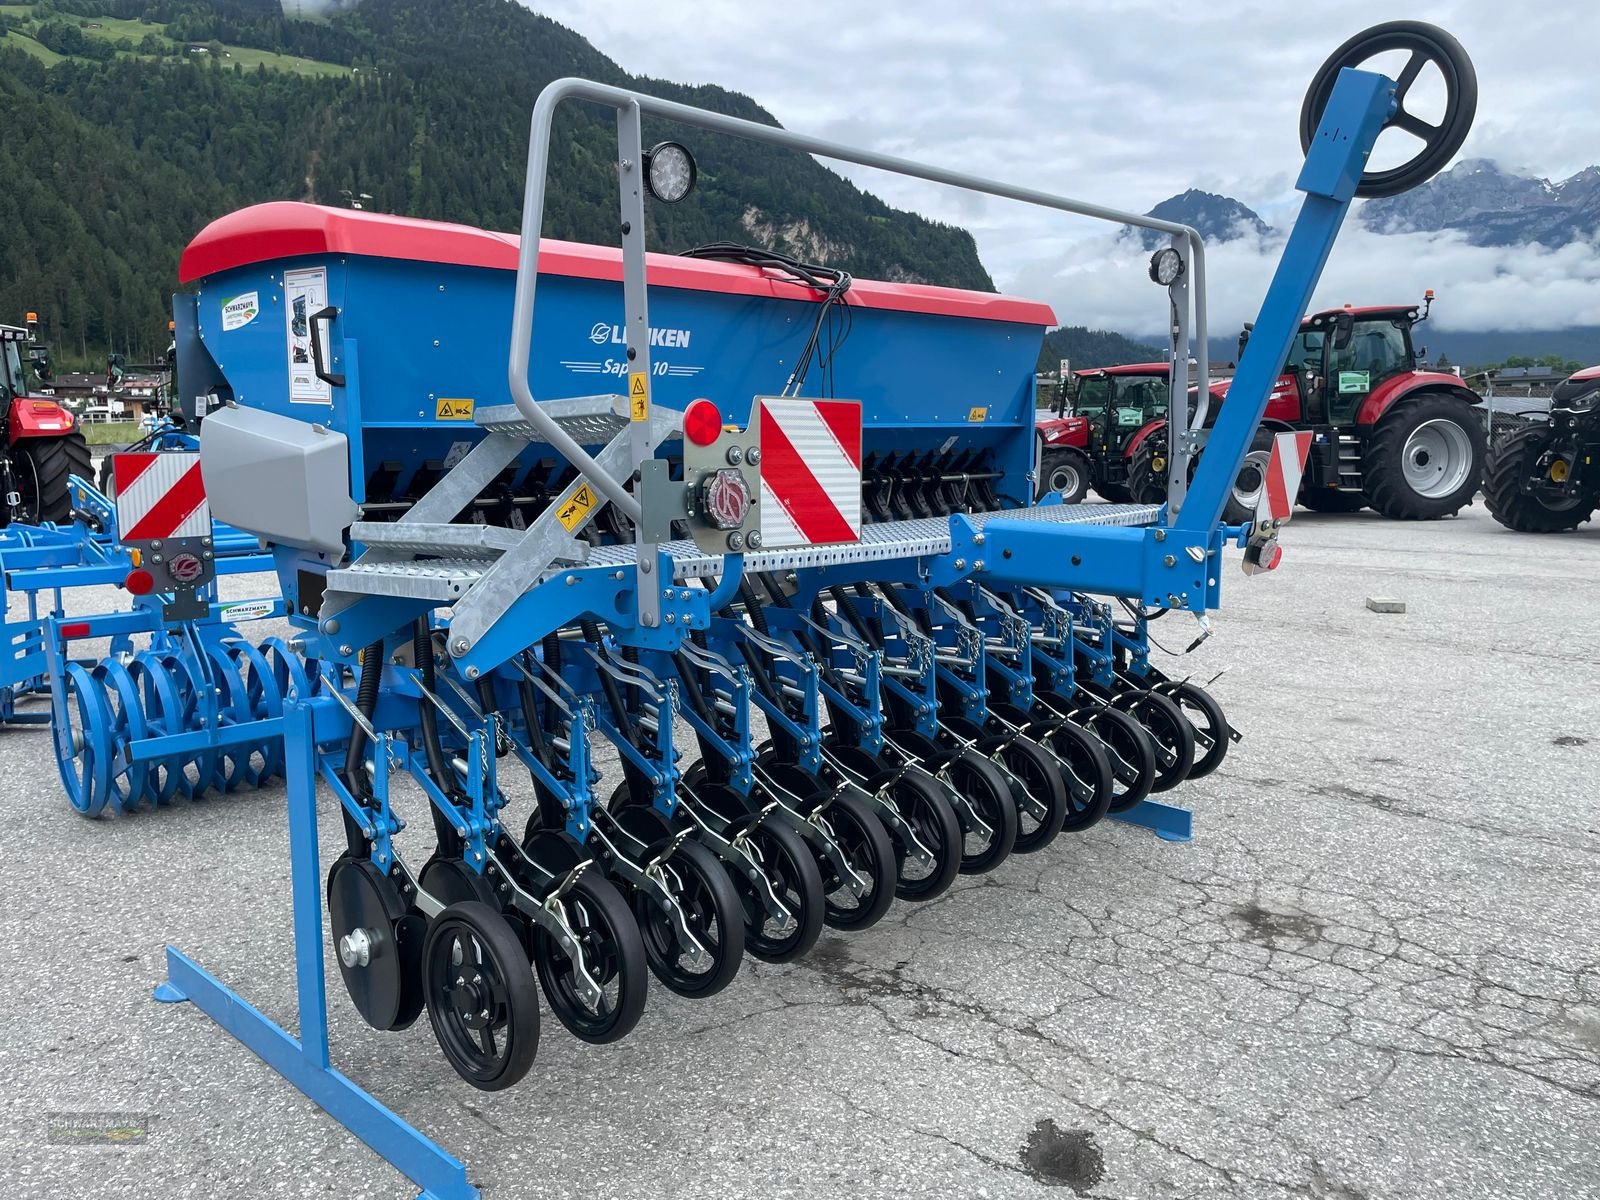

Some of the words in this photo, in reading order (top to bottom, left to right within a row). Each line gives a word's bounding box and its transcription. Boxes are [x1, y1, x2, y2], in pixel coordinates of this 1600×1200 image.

[611, 325, 690, 348] LKEN
[653, 361, 668, 376] 10
[226, 606, 267, 614] SCHWARZMAYR
